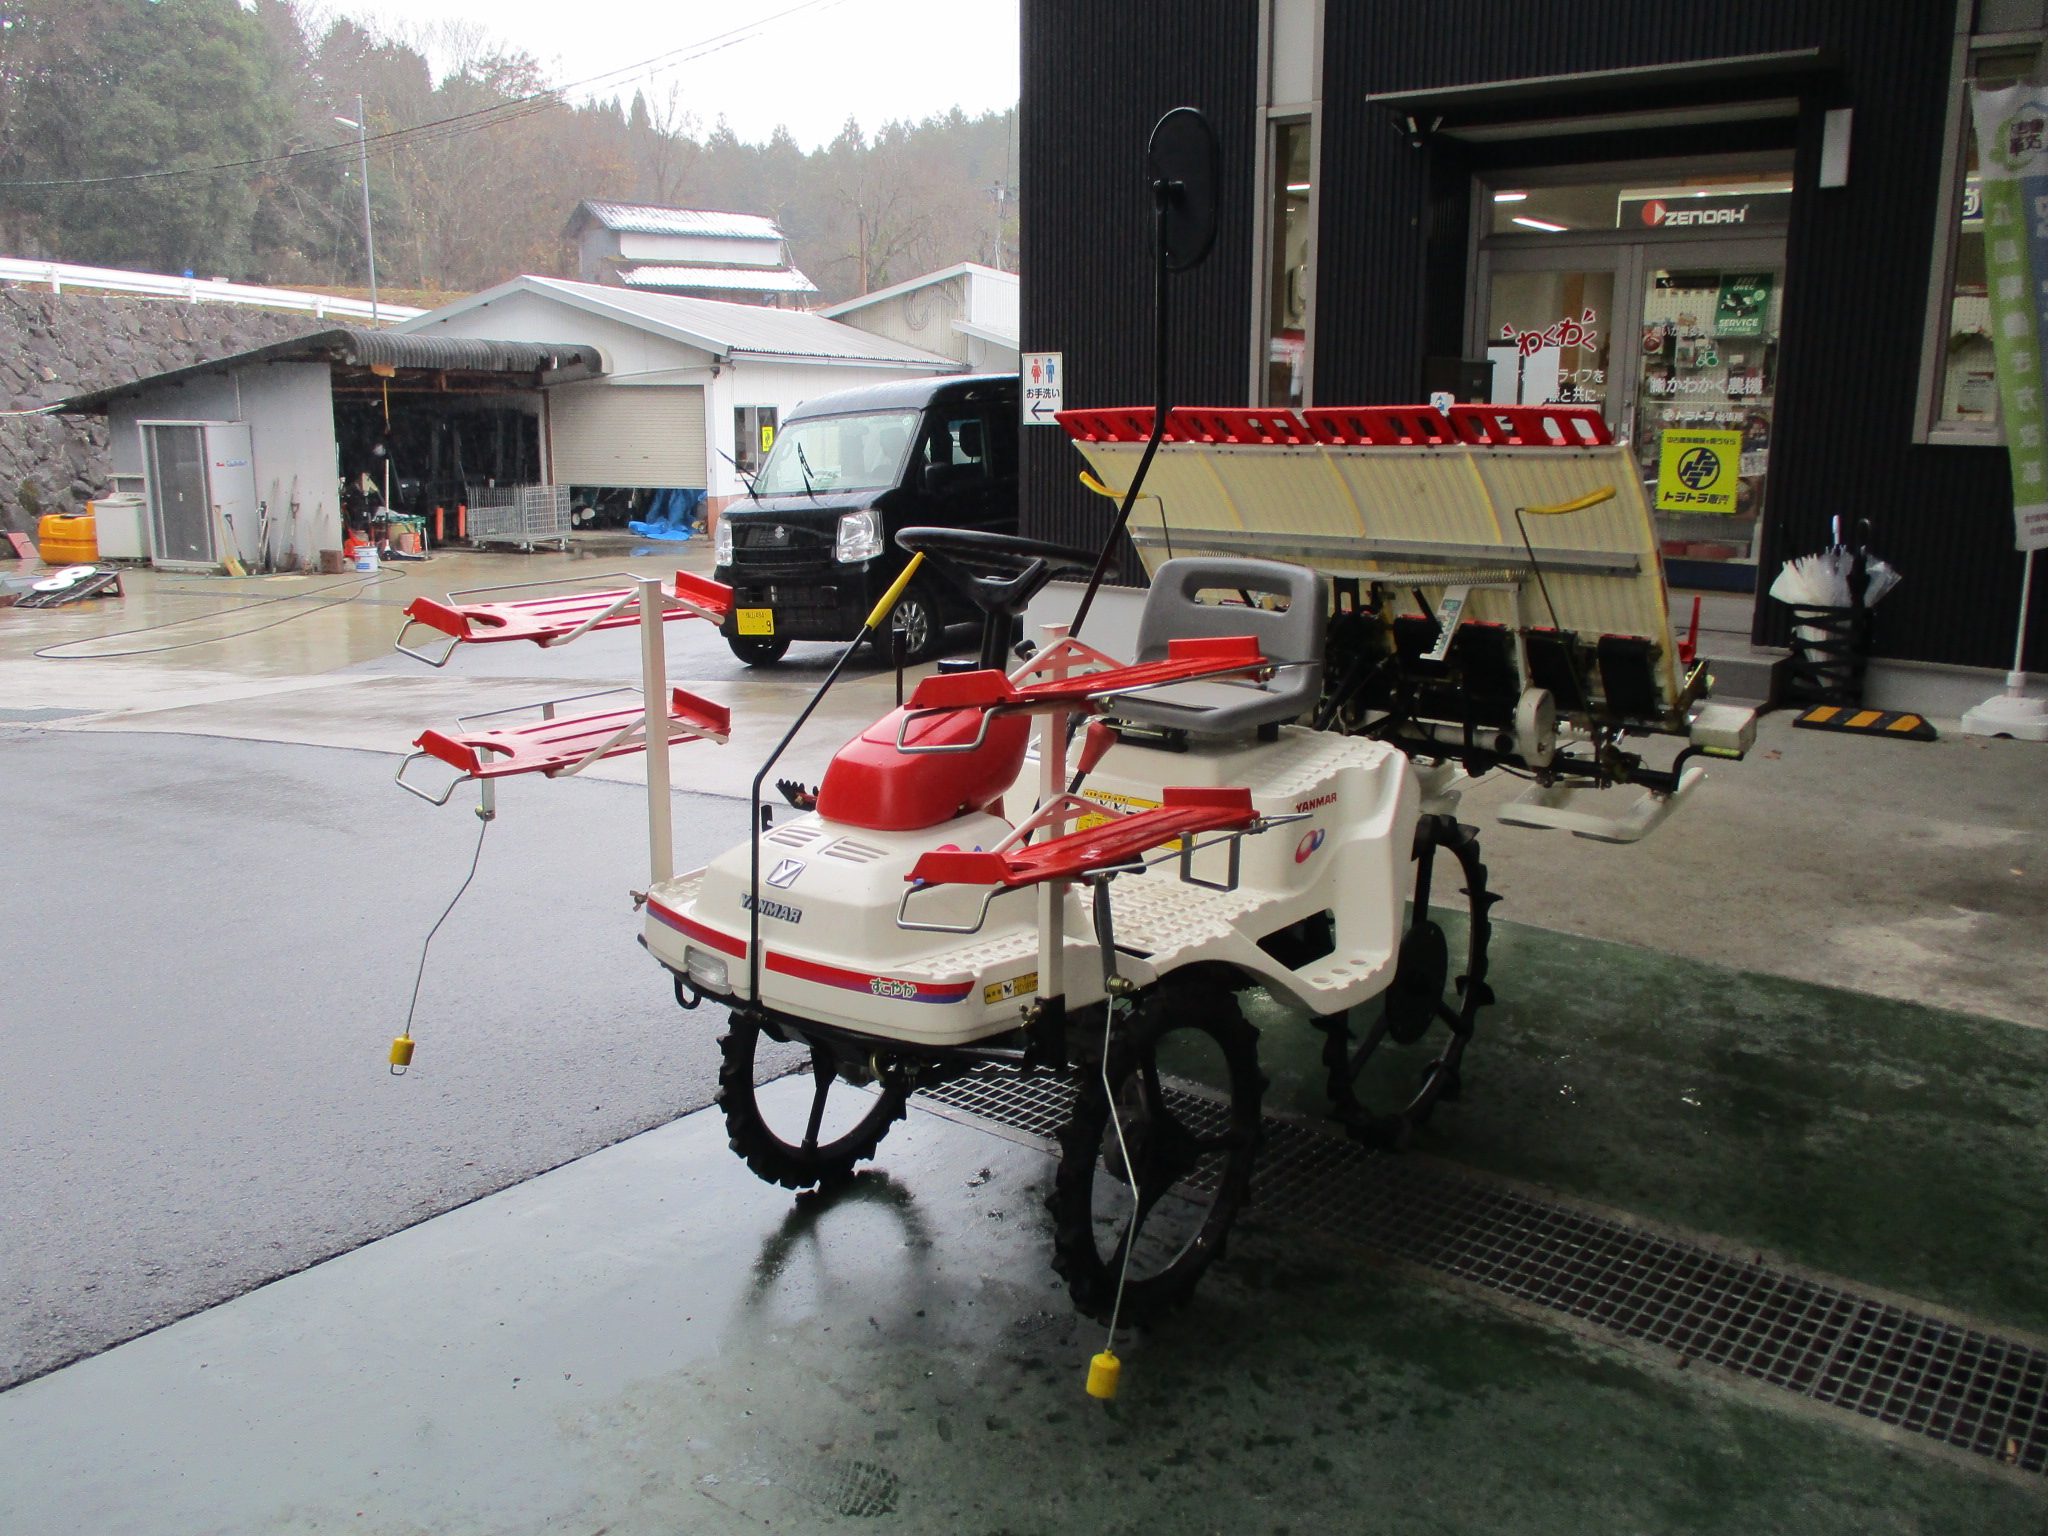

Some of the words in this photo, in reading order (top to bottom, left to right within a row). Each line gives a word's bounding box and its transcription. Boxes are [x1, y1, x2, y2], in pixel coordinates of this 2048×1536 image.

[1664, 209, 1745, 226] ZENOAH
[1719, 318, 1759, 327] SERVICE
[1515, 317, 1597, 358] わくわく
[1026, 388, 1060, 399] お手洗い
[766, 620, 772, 633] 9
[1296, 792, 1338, 813] YANMAR
[869, 978, 918, 999] すこやか
